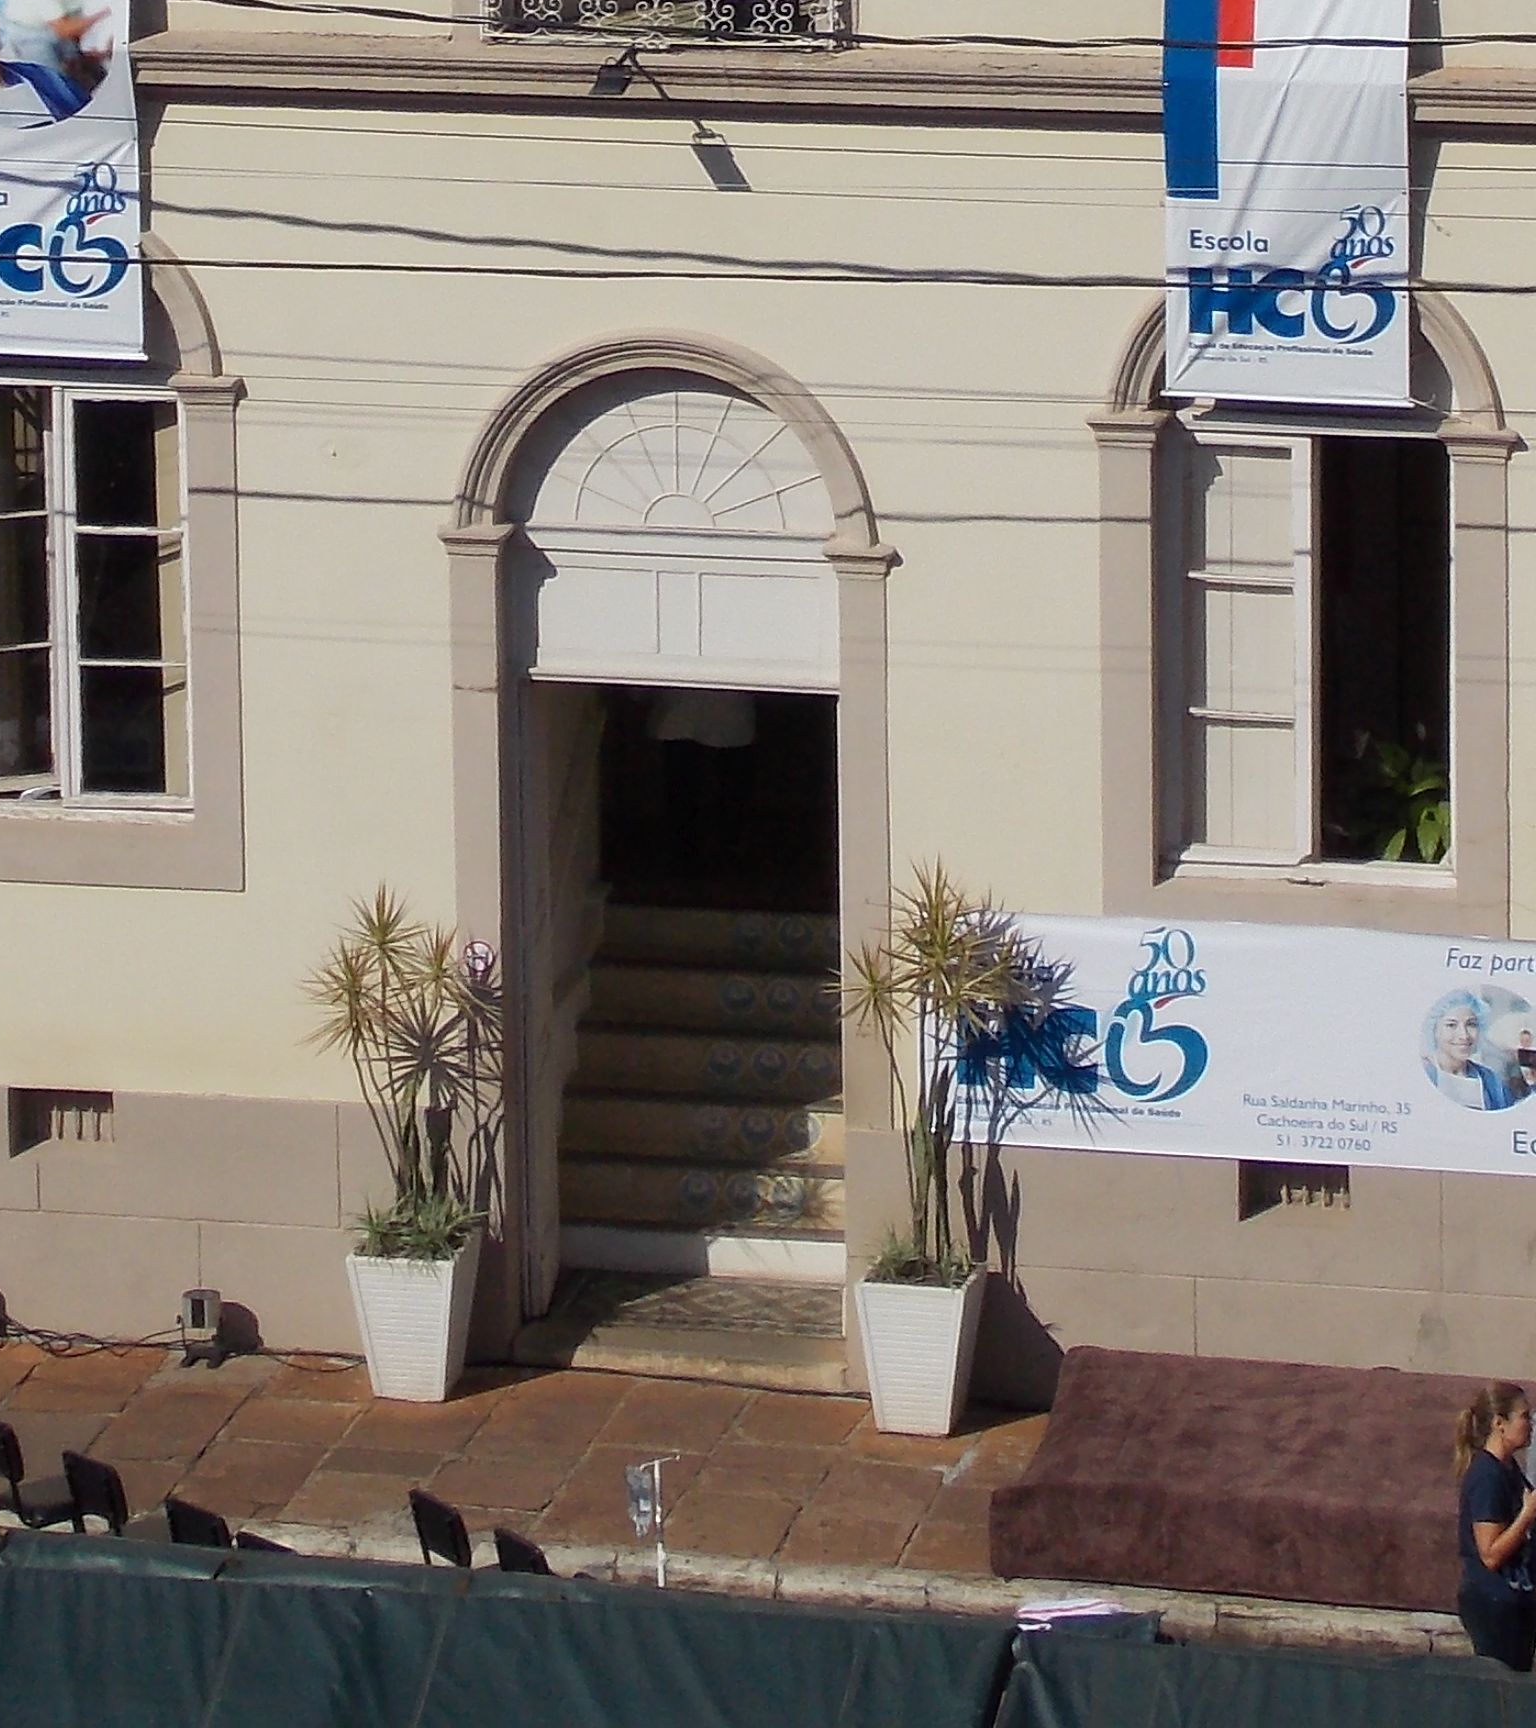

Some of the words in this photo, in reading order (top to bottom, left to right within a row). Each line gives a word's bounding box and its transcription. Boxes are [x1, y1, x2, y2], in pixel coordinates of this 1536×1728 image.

[73, 162, 117, 193] 50
[67, 192, 126, 214] anos
[1333, 204, 1385, 240] 50
[1190, 229, 1269, 253] Escola
[1331, 236, 1394, 259] anos
[1133, 926, 1194, 971] 50
[1446, 948, 1483, 970] Faz
[1128, 968, 1206, 995] anos
[1242, 1093, 1267, 1106] Rua
[1271, 1095, 1328, 1110] Saldanha
[1395, 1102, 1412, 1115] 35
[1256, 1114, 1324, 1129] Cachoeira
[1328, 1117, 1346, 1131] do
[1349, 1118, 1369, 1133] Sul
[1381, 1121, 1398, 1134] RS
[1302, 1135, 1333, 1150] 3722
